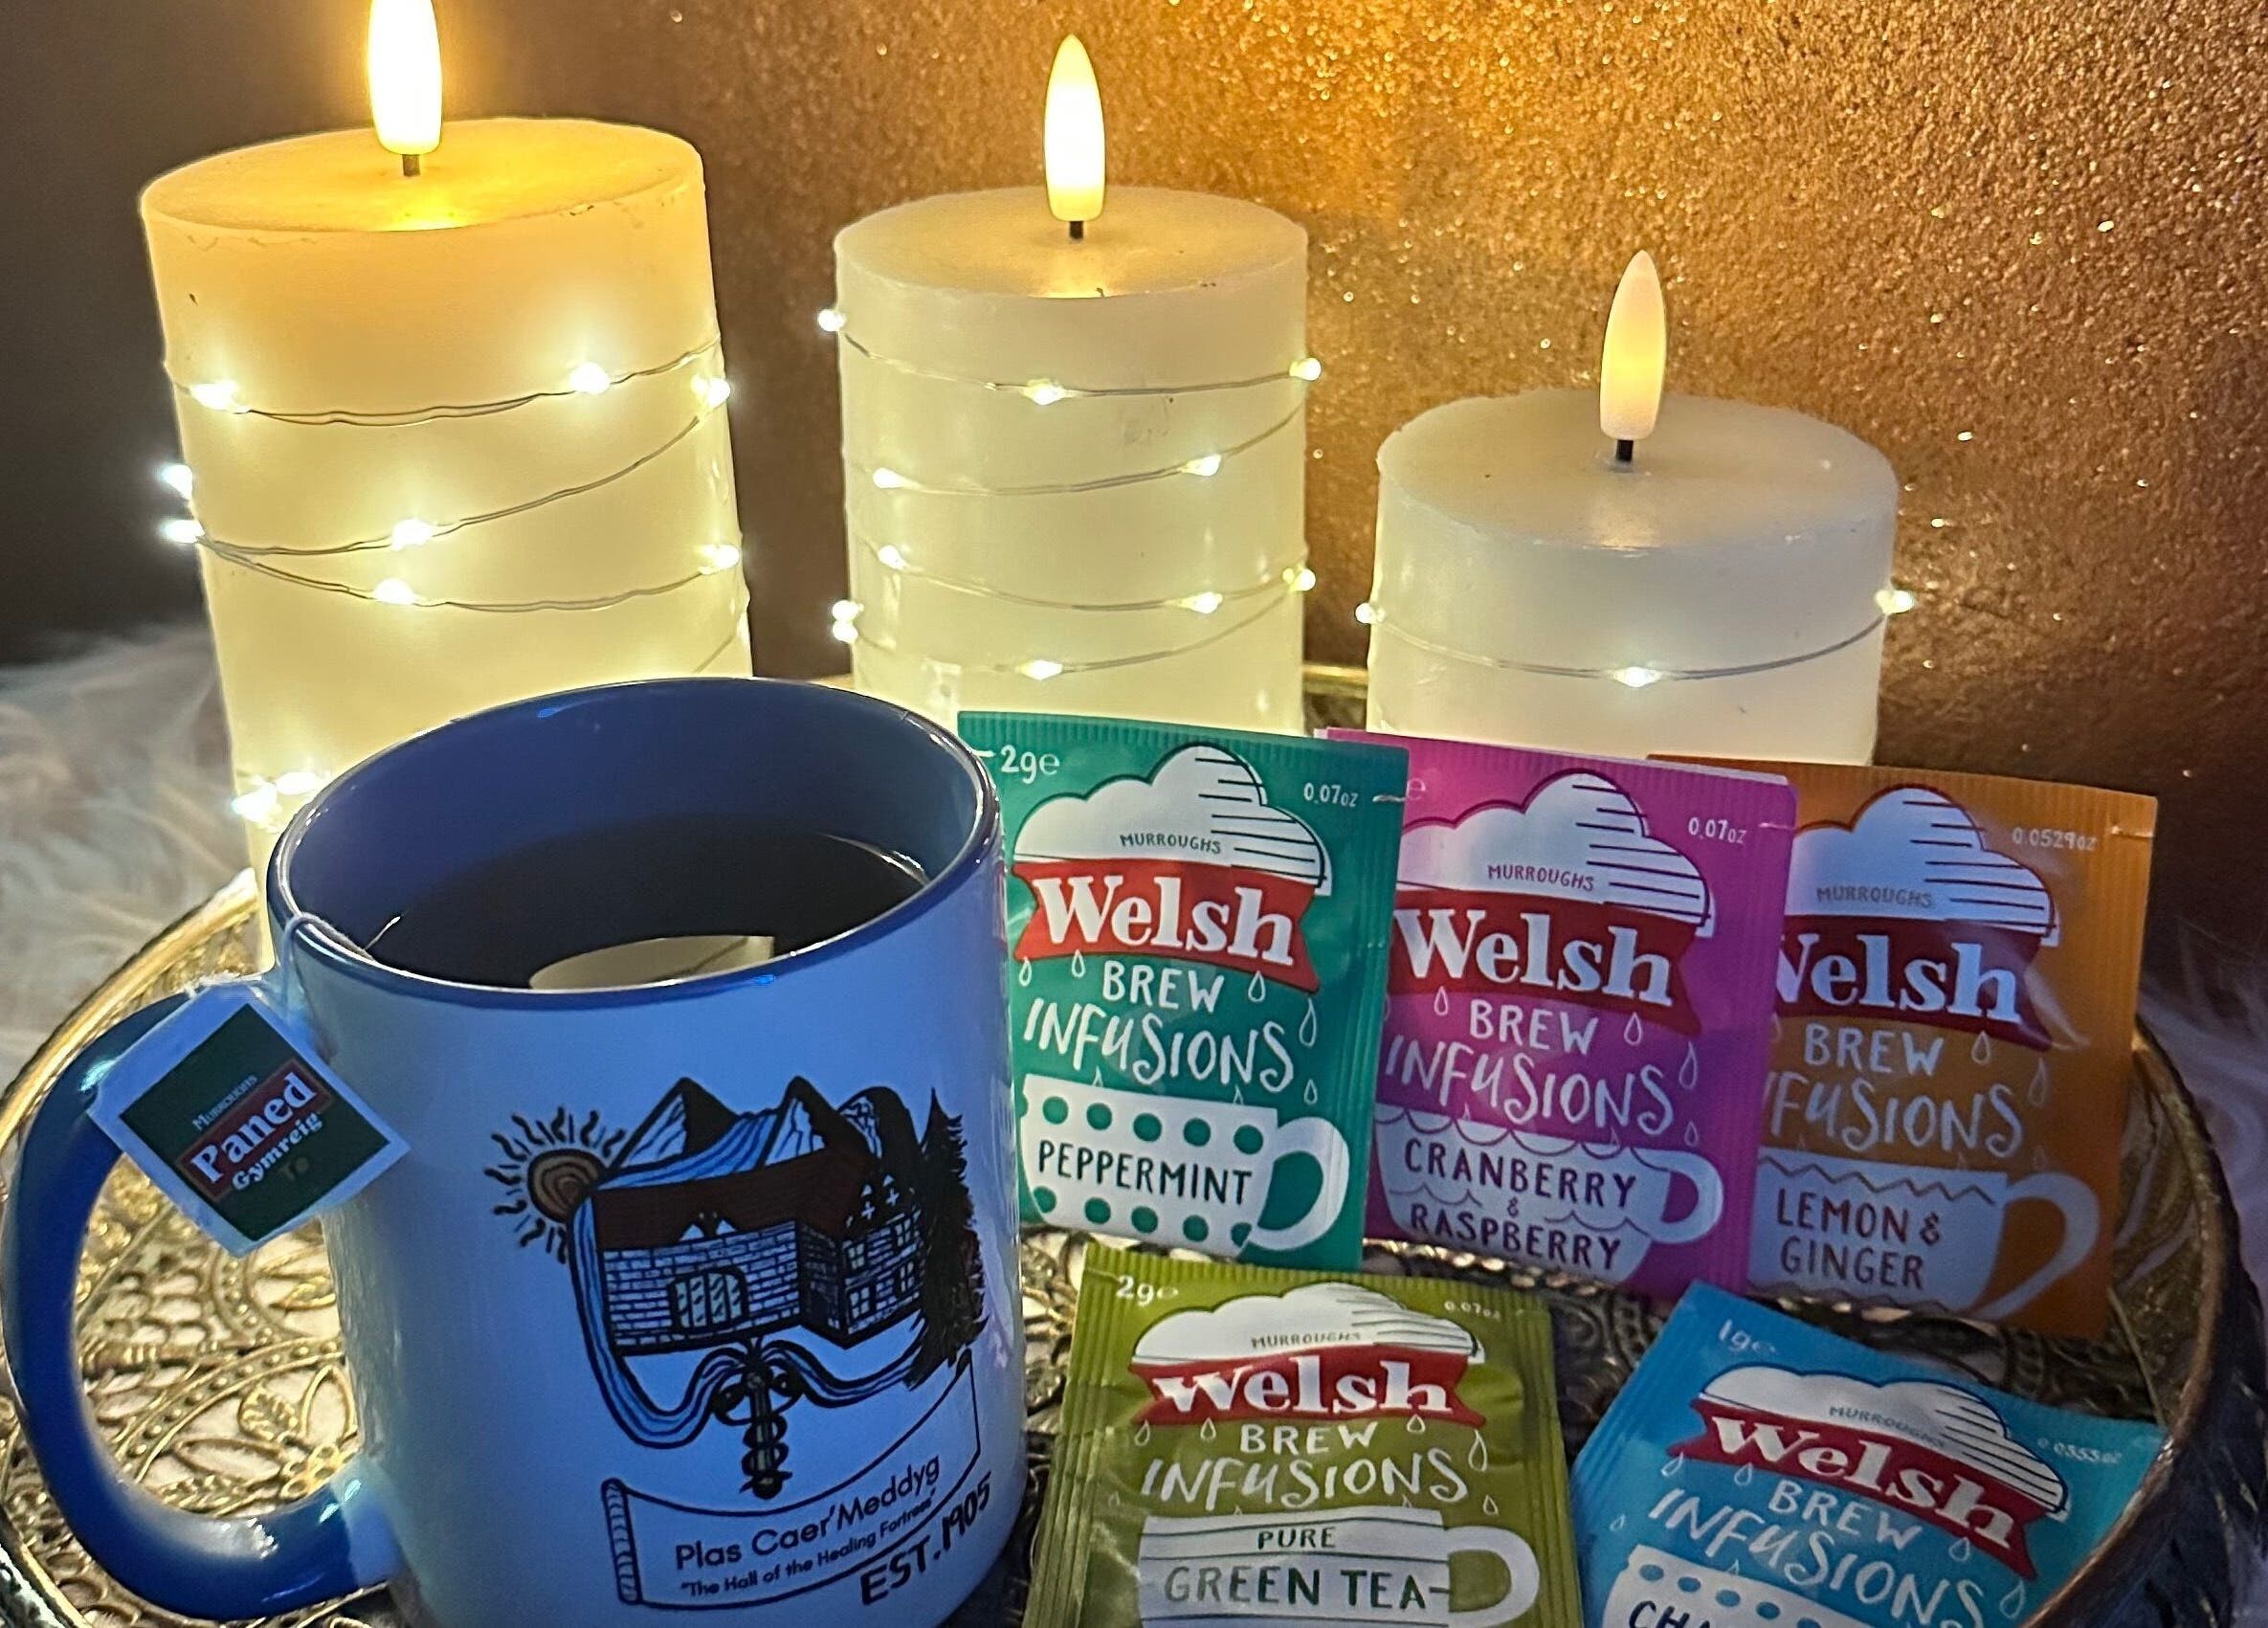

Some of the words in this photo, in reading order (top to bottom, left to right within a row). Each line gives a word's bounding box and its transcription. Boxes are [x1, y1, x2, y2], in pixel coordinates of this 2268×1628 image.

[1302, 781, 1359, 808] 0.07oz
[1119, 834, 1223, 855] MURROUGHS
[1687, 816, 1747, 844] 0.07oz
[1487, 863, 1595, 892] MURROUGHS
[1815, 886, 1934, 910] MURROUGHS
[1032, 875, 1295, 967] Welsh
[1101, 960, 1225, 1014] BREW
[1392, 907, 1673, 1007] Welsh
[1023, 997, 1295, 1094] INFUSIONS
[1469, 999, 1600, 1057] BREW
[1804, 1022, 1946, 1078] BREW
[1385, 1034, 1674, 1136] INFUSIONS
[1763, 1070, 2024, 1159] FUSIONS
[190, 1070, 318, 1185] Paned
[232, 1110, 323, 1191] Gymreig
[1038, 1139, 1254, 1206] PEPPERMINT
[1404, 1137, 1638, 1210] CRANBERRY
[1410, 1202, 1623, 1272] RASPBERRY
[1505, 1196, 1522, 1218] &
[1776, 1187, 1910, 1244] LEMON
[1918, 1211, 1943, 1247] &
[1779, 1236, 1925, 1291] GINGER
[1250, 1331, 1362, 1349] MURROUGHS
[1152, 1354, 1453, 1415] Welsh
[1240, 1421, 1379, 1457] BREW
[1140, 1447, 1469, 1512] INFUSIONS
[1711, 1416, 2016, 1550] Welsh
[1257, 1527, 1338, 1550] PURE
[1768, 1482, 1923, 1551] BREW
[675, 1540, 744, 1571] Plas
[724, 1569, 759, 1592] Hall
[763, 1563, 782, 1584] of
[786, 1558, 814, 1578] the
[817, 1531, 878, 1567] Healing
[1647, 1488, 1986, 1628] INFUSIONS
[1164, 1564, 1323, 1606] GREEN
[1341, 1569, 1427, 1611] TEA
